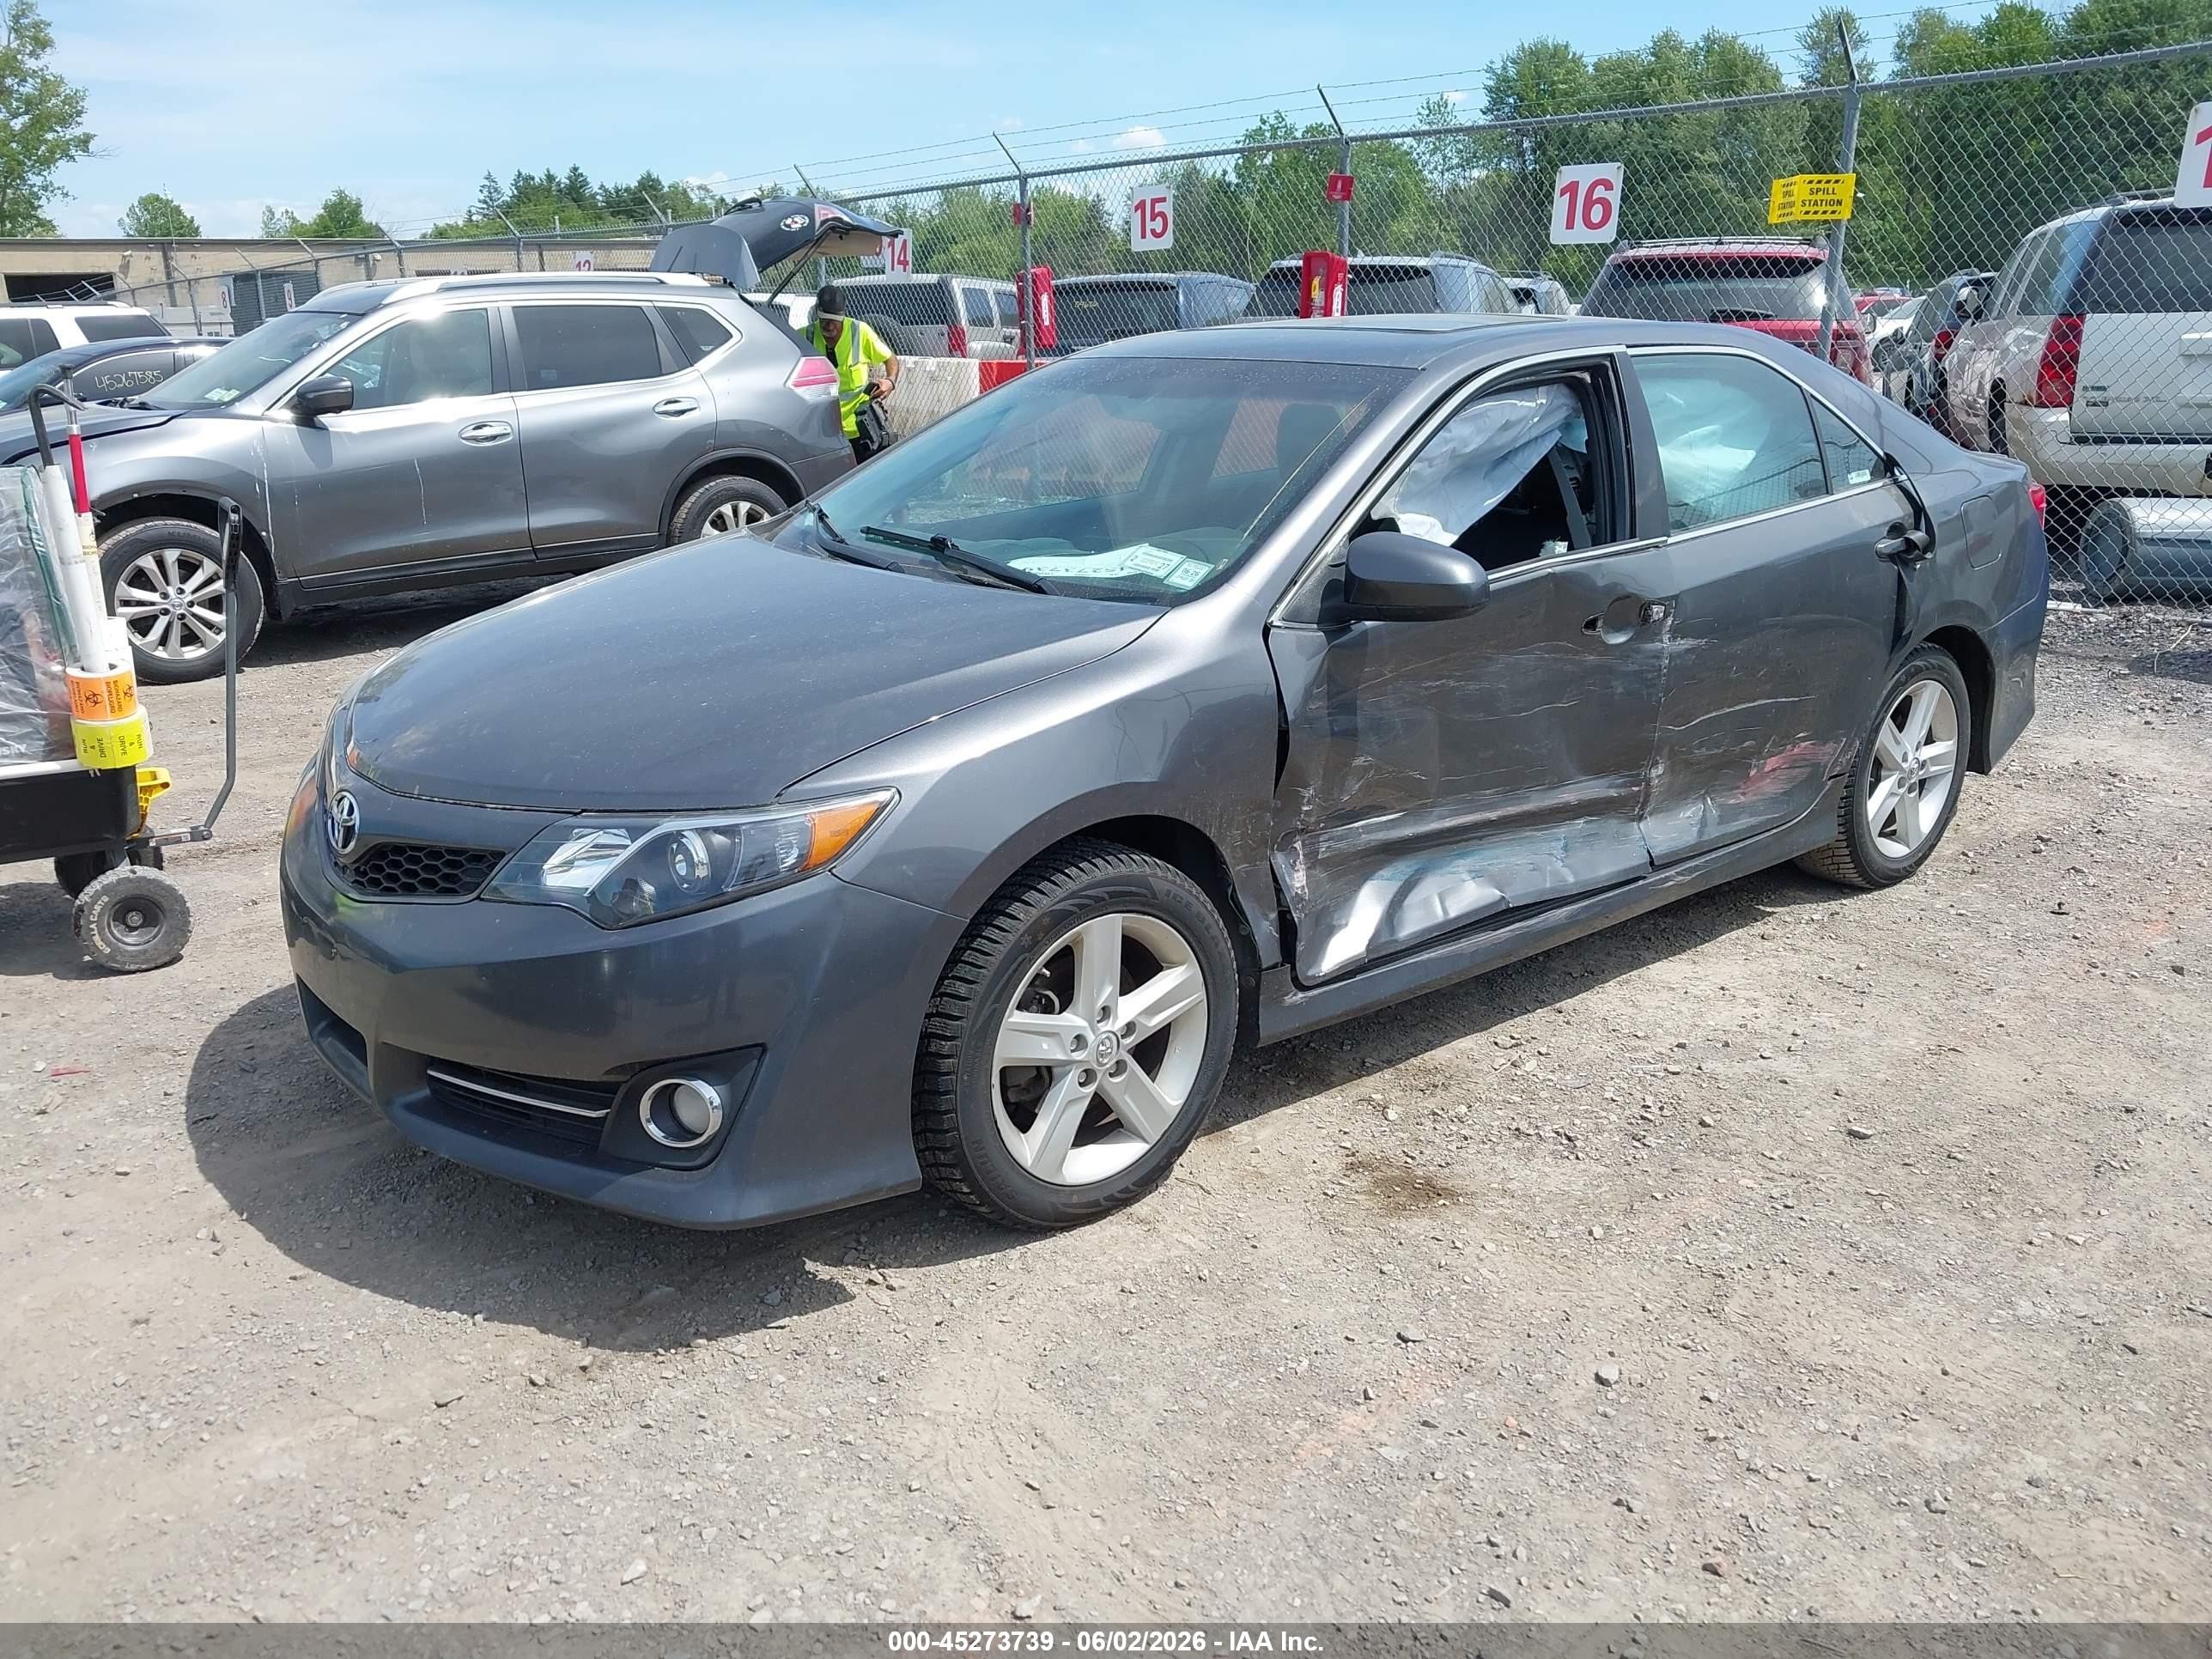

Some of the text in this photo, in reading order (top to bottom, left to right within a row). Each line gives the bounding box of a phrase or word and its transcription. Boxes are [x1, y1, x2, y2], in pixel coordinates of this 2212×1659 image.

[1559, 178, 1613, 230] 16
[1783, 190, 1794, 199] SPILL
[1801, 198, 1843, 207] STATION
[1133, 197, 1169, 240] 15
[888, 236, 909, 272] 14
[221, 291, 227, 308] 8
[287, 289, 292, 308] 9
[94, 370, 163, 392] 45267585
[105, 681, 116, 714] BIOPELIGRO
[112, 680, 123, 712] BIOHAZARD
[96, 737, 106, 758] DRIVE
[118, 735, 128, 757] DRIVE
